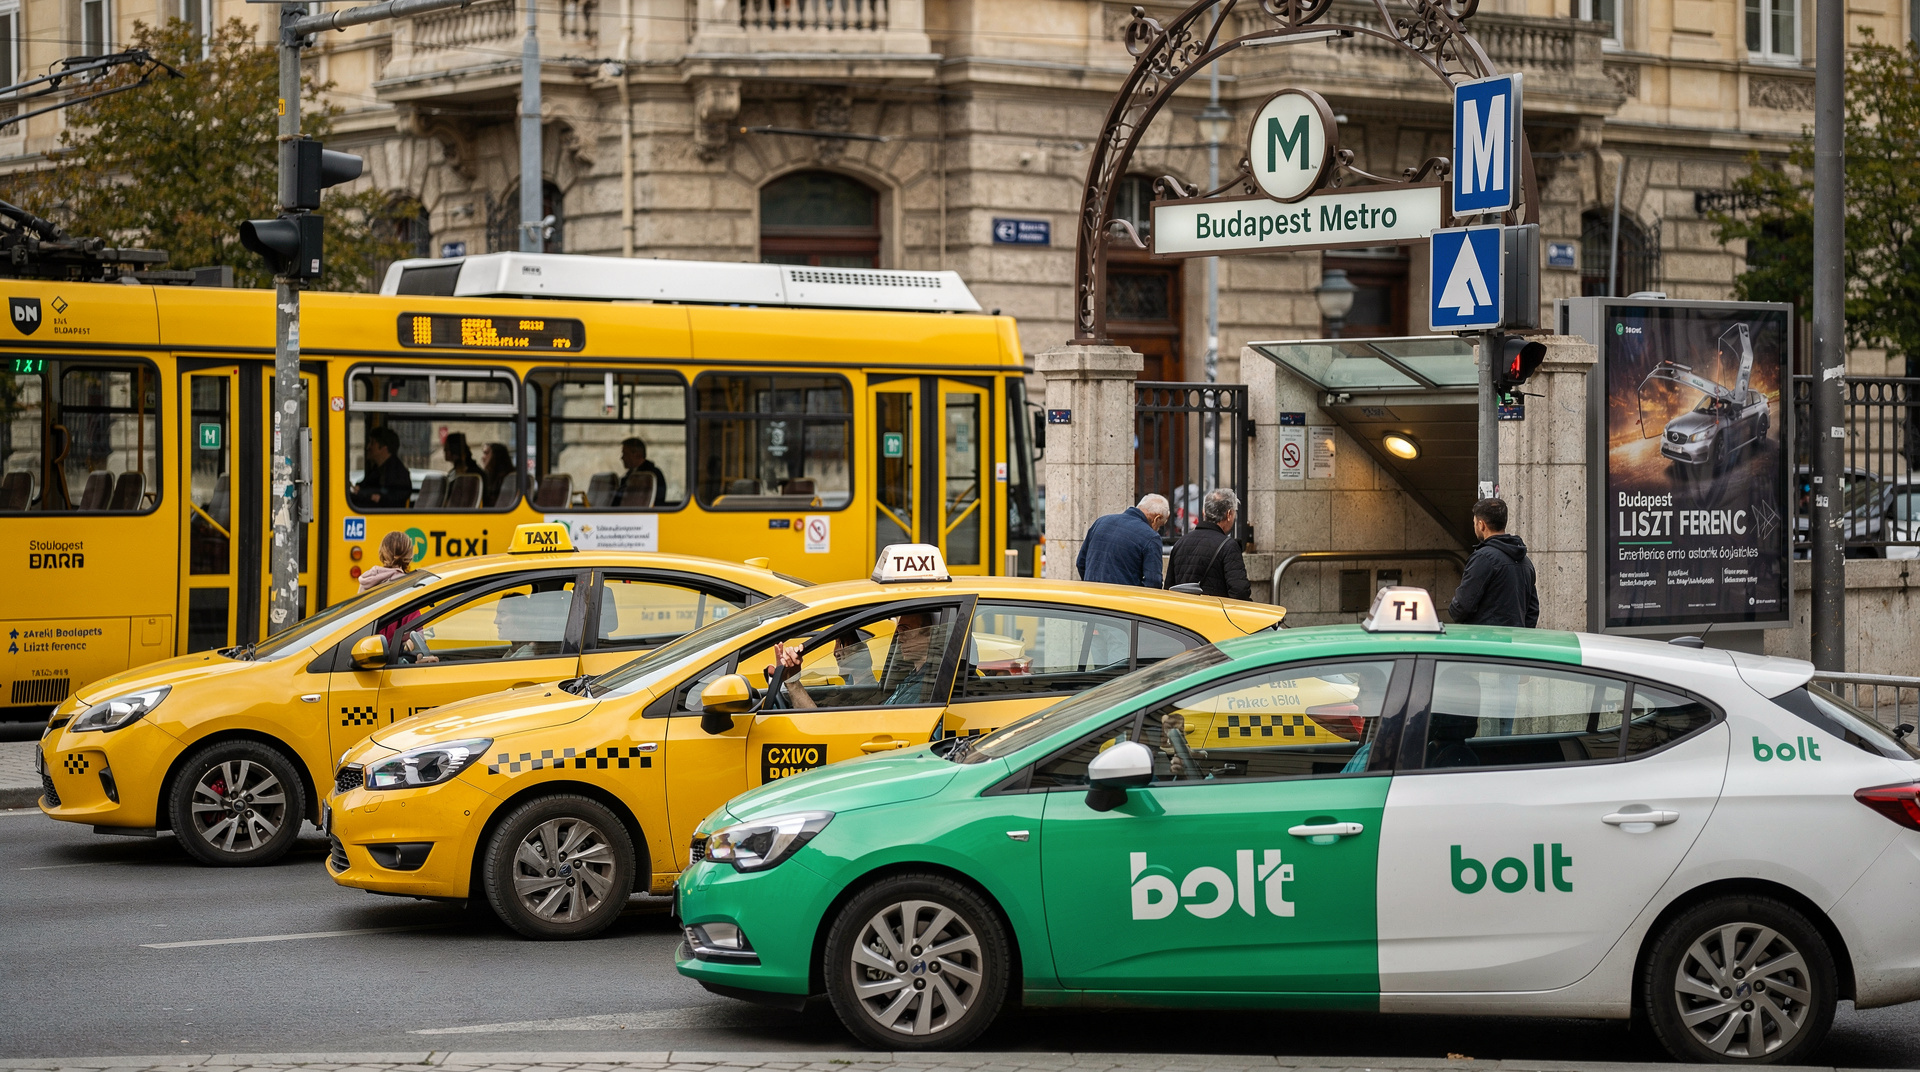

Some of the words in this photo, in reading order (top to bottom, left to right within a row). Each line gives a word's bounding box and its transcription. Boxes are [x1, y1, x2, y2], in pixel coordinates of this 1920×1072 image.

[1267, 114, 1310, 173] M
[1461, 93, 1505, 195] M
[1196, 208, 1311, 241] Budapest
[1320, 203, 1397, 232] Metro
[1618, 491, 1673, 511] Budapest
[1619, 510, 1674, 537] LISZT
[1679, 509, 1747, 536] FERENC
[430, 529, 488, 557] Taxi
[525, 531, 558, 545] TAXI
[893, 555, 936, 572] TAXI
[1752, 736, 1822, 762] bolt
[1450, 843, 1574, 894] bolt
